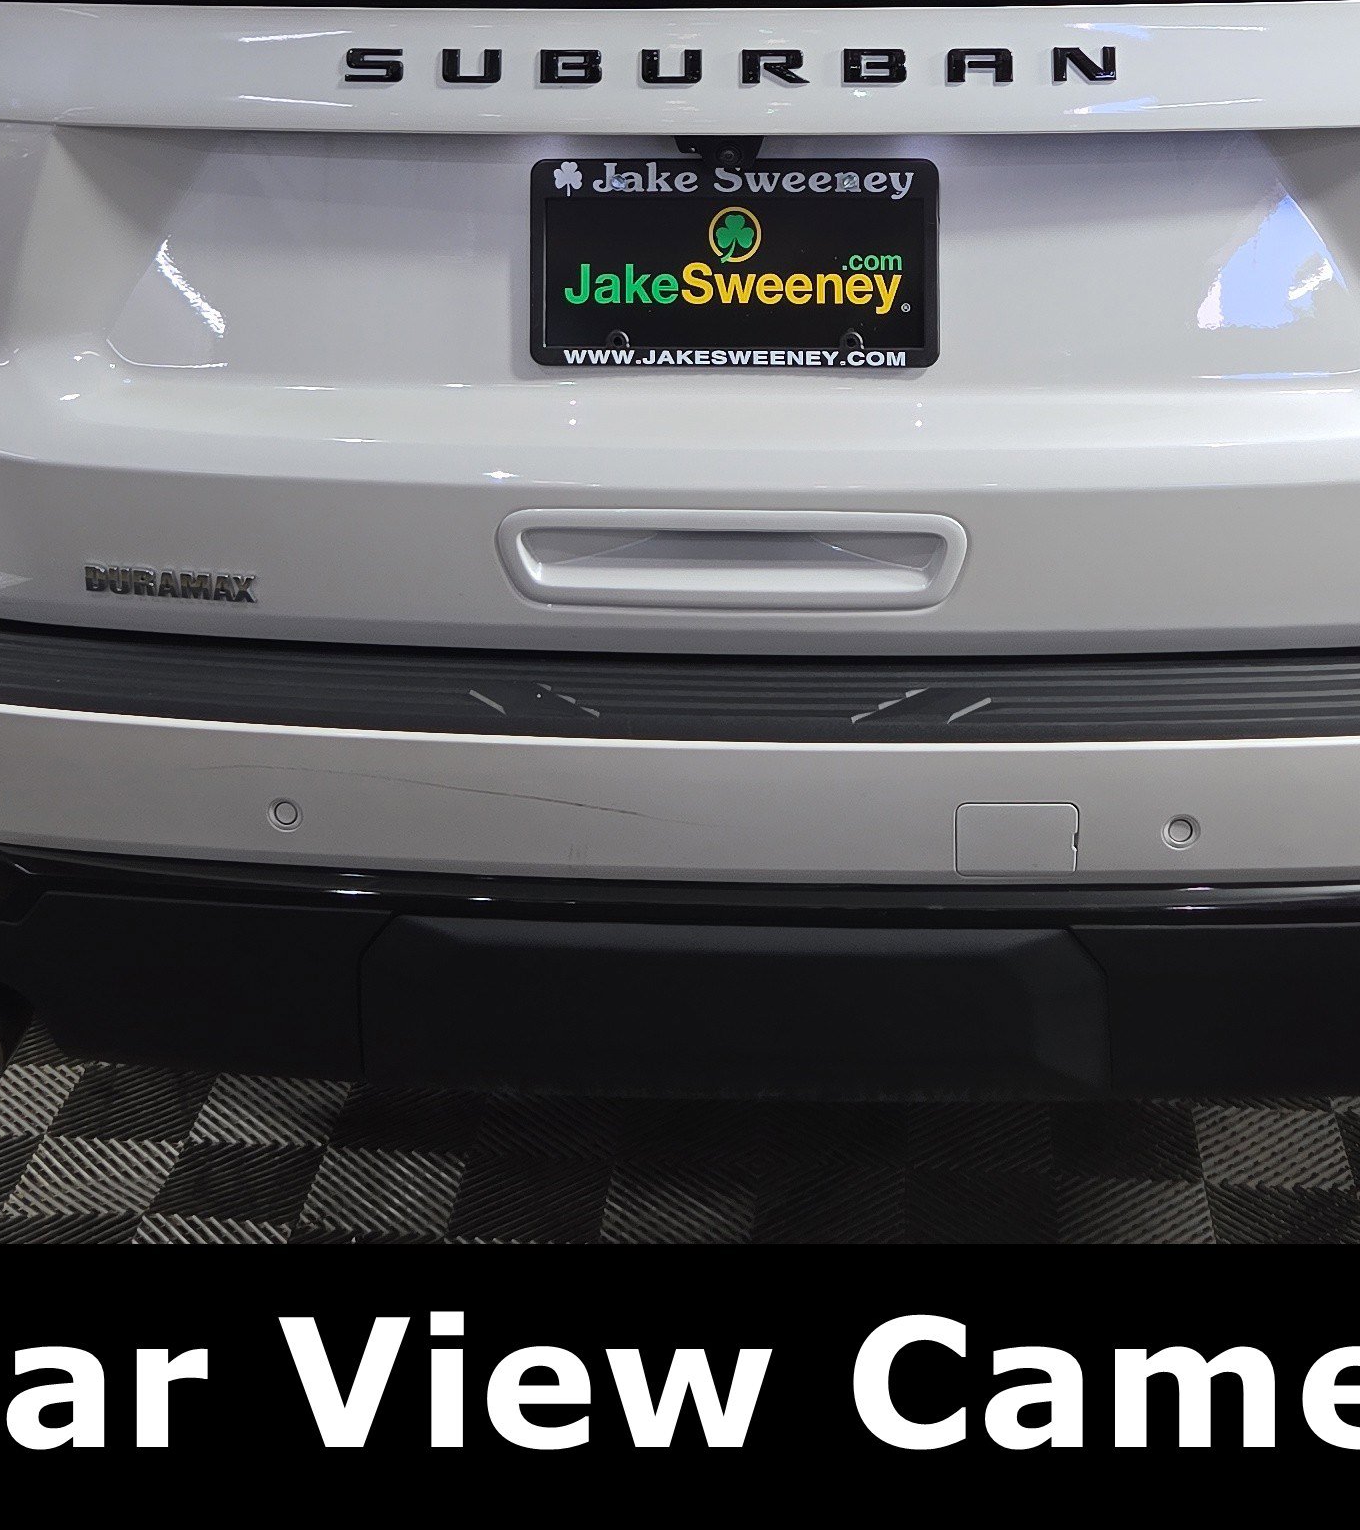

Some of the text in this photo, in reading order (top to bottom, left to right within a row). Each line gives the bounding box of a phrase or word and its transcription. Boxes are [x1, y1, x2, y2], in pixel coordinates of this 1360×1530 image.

[344, 46, 1118, 84] SUBURBAN
[592, 162, 915, 200] Jake Sweeney
[563, 348, 907, 367] WWW.JAKESWEENEY.COM
[85, 565, 258, 604] DURAMAX
